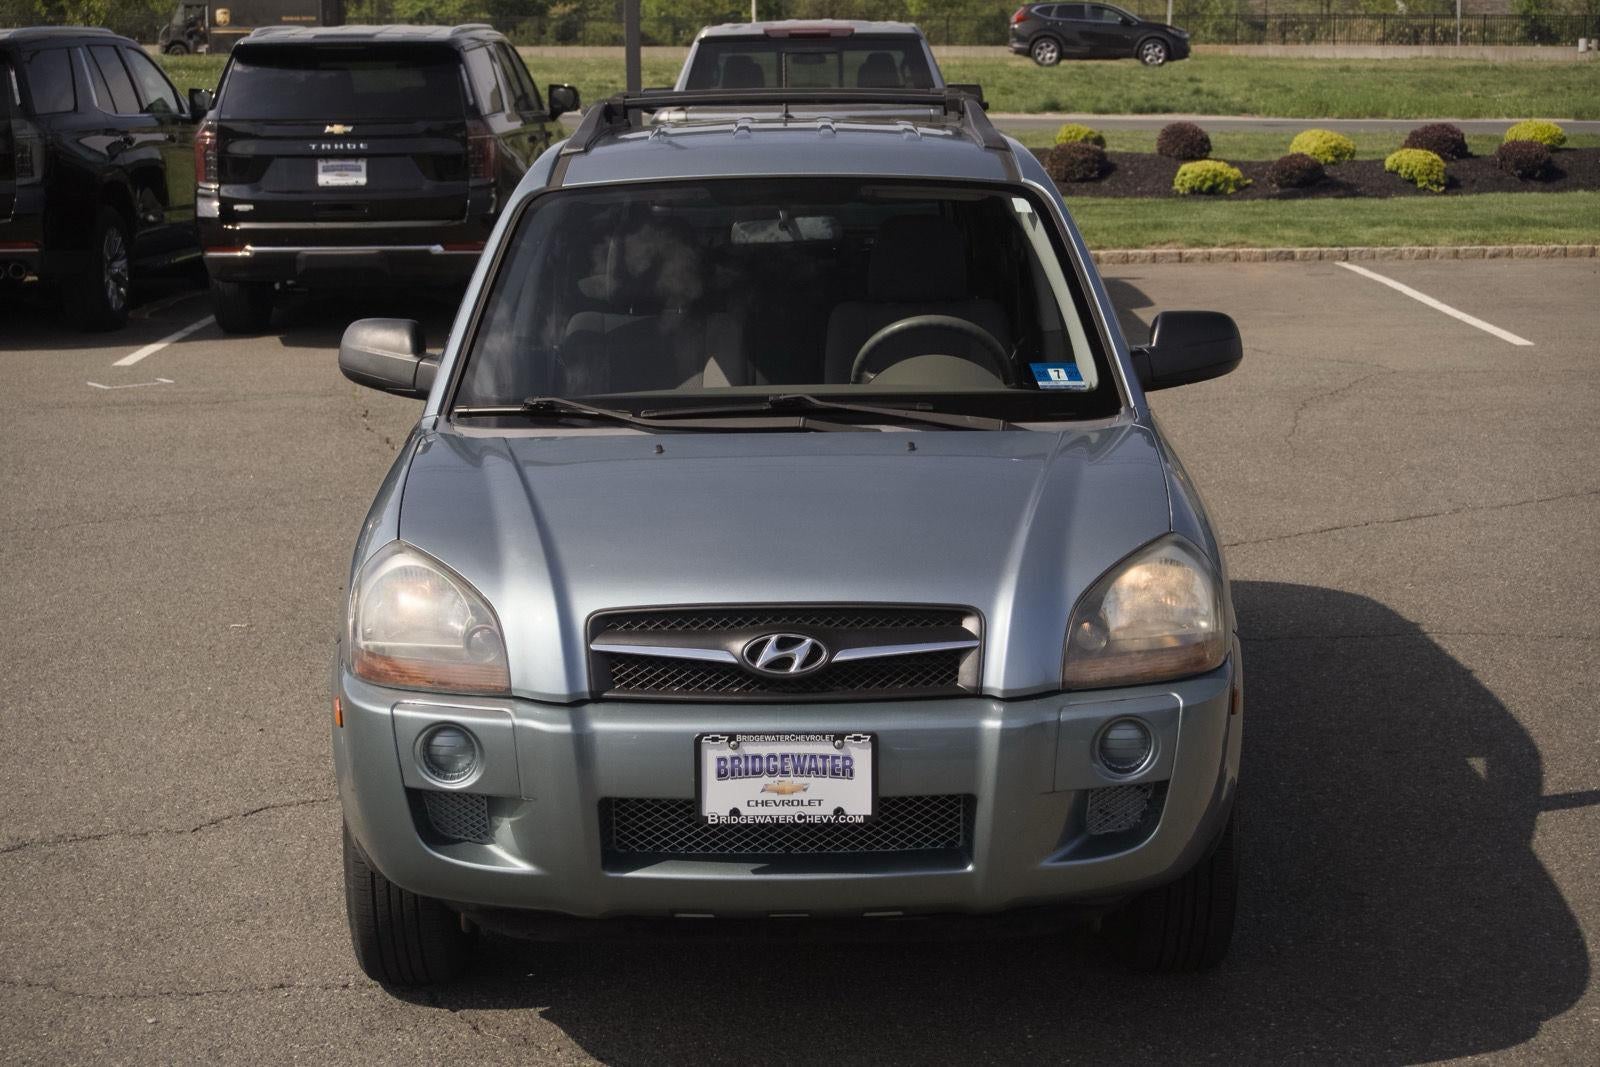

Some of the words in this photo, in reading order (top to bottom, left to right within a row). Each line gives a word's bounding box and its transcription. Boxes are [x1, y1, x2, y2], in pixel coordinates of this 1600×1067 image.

[309, 142, 368, 150] TAHOE
[1053, 369, 1061, 379] 7
[736, 734, 835, 742] BRIDGEWATERCHEVROLET
[716, 753, 855, 780] BRIDGEWATER
[746, 799, 824, 808] CHEVROLET
[707, 812, 864, 825] BRIDGEWATERCHEVY.COM
